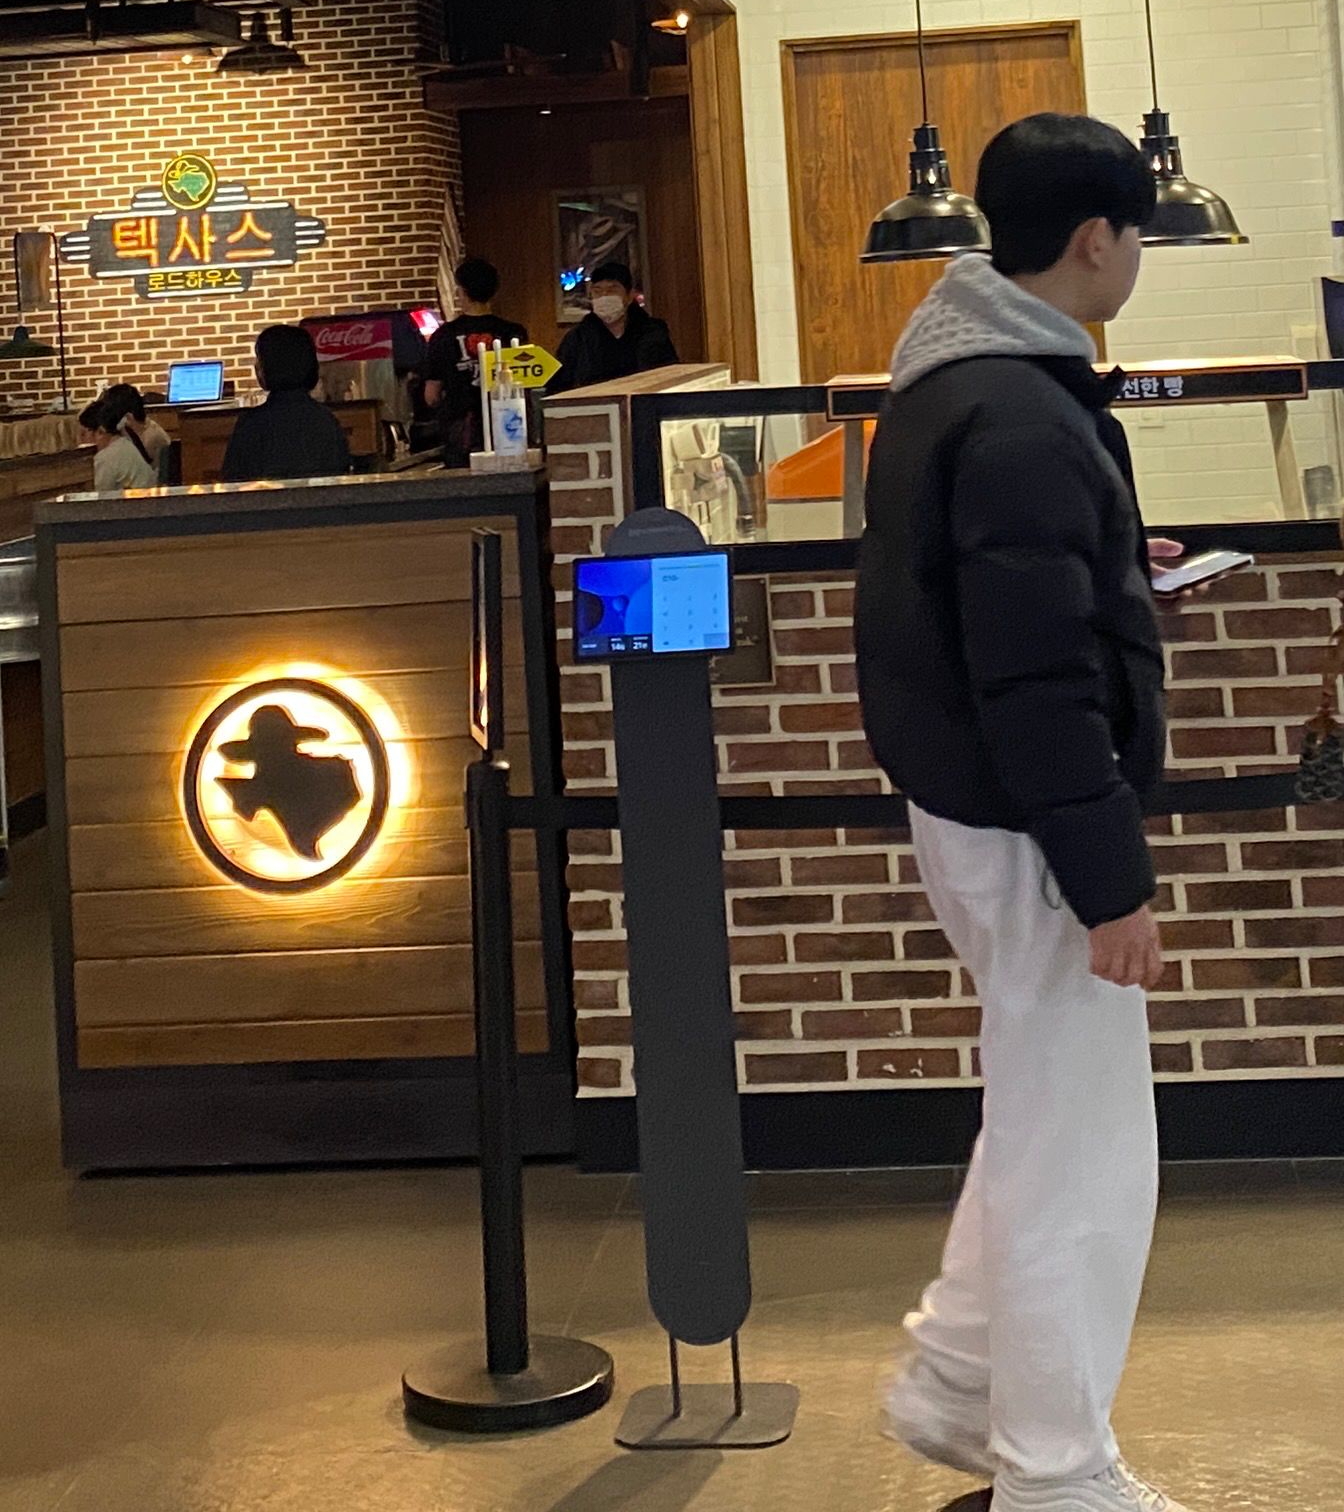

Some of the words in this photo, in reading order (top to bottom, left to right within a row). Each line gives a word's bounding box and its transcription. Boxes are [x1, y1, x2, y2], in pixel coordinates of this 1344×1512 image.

[112, 211, 275, 266] 텍사스
[147, 270, 242, 290] 로드하우스
[1116, 377, 1159, 399] 선한
